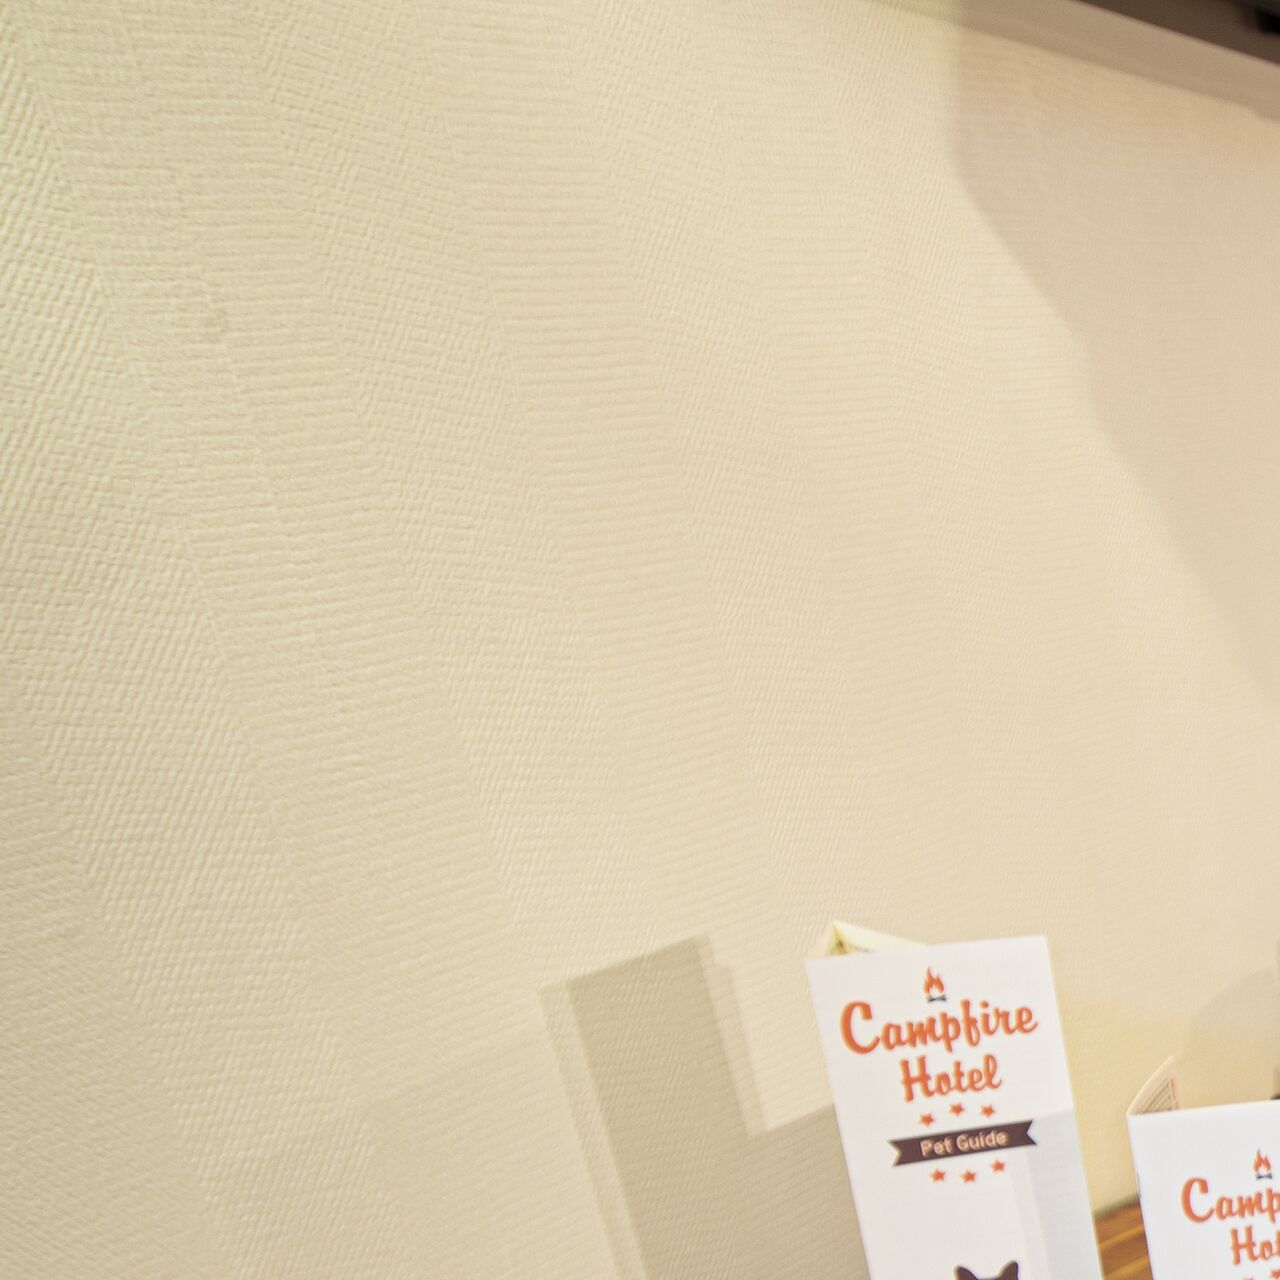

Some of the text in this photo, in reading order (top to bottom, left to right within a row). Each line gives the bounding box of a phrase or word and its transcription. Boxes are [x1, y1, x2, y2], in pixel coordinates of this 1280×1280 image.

[839, 999, 1038, 1056] Campfire
[900, 1053, 1001, 1104] Hotel
[920, 1131, 1009, 1157] Pet Guide
